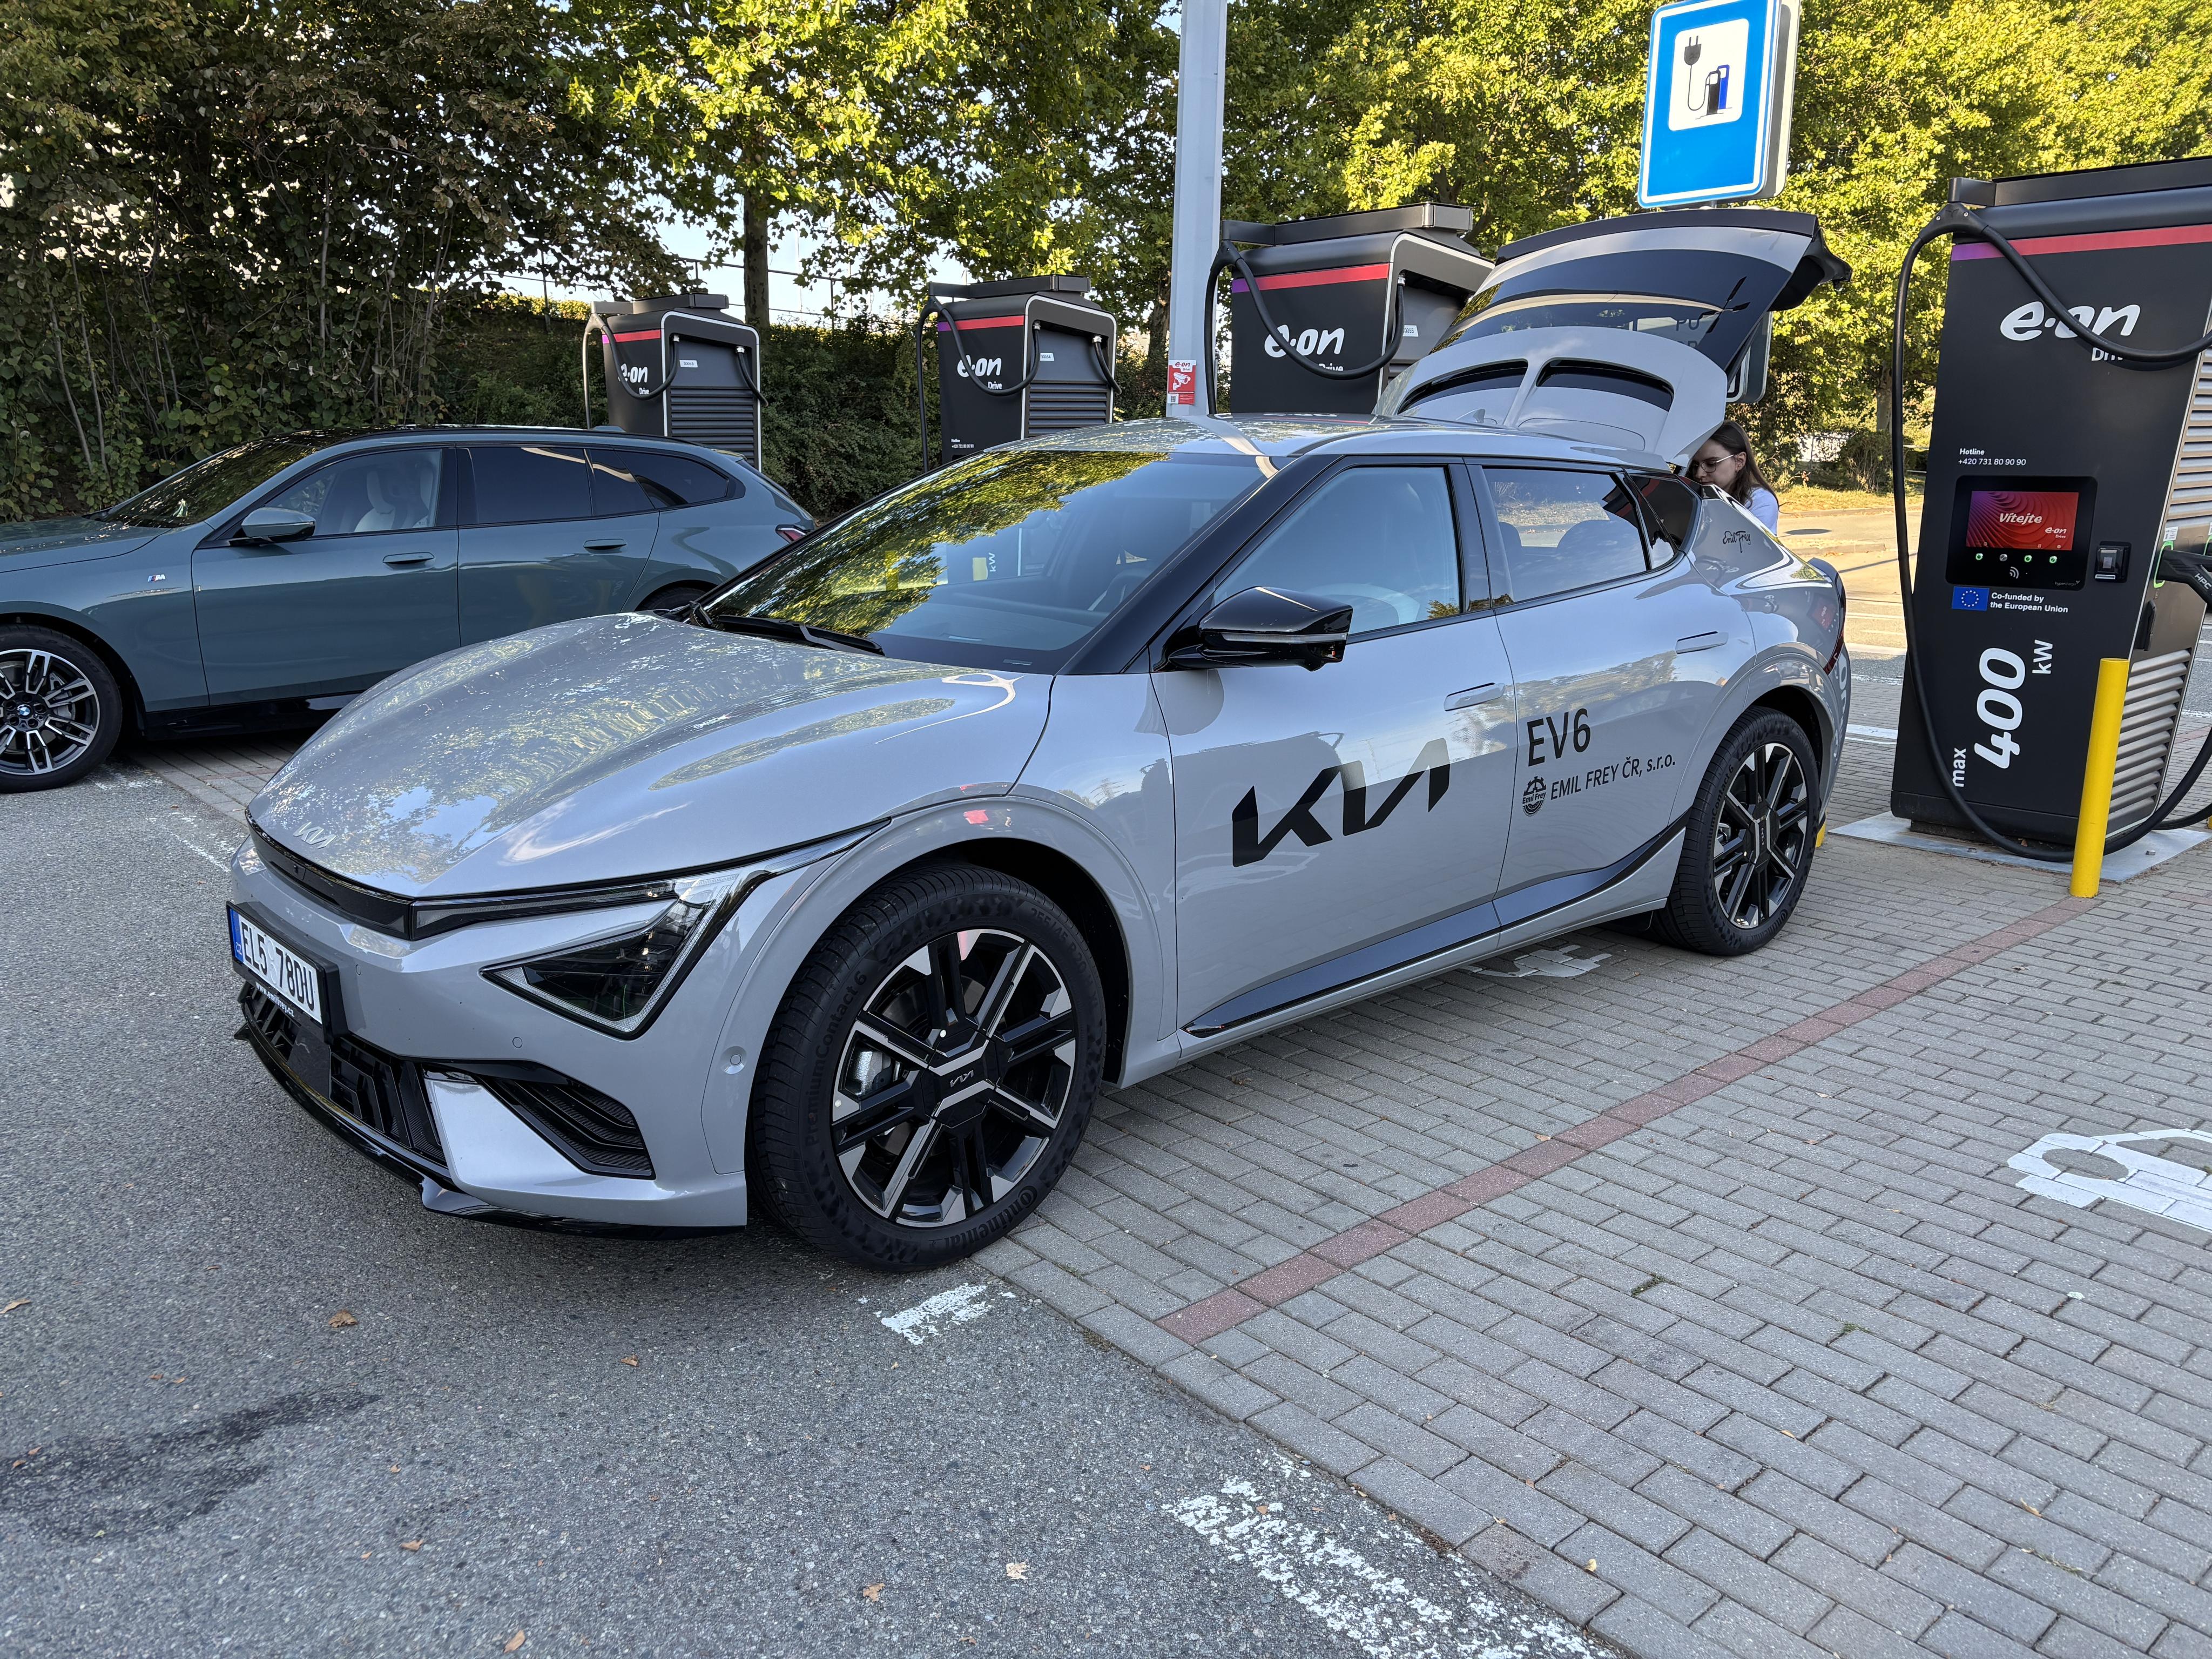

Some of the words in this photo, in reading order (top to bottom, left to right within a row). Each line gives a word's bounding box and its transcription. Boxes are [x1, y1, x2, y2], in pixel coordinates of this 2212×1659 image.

[1999, 512, 2042, 525] Vítejte
[988, 552, 996, 572] kW
[2195, 573, 2212, 590] HPC
[1991, 592, 2032, 601] Co-funded
[2034, 595, 2045, 603] by
[2005, 602, 2042, 611] European
[2032, 639, 2053, 674] kW
[1974, 648, 2026, 769] 400
[1527, 708, 1591, 767] EV6
[1551, 775, 1581, 800] EMIL
[1586, 764, 1620, 790] FREY
[1622, 756, 1642, 777] ČR,
[1647, 754, 1676, 772] s.r.o.
[1728, 764, 1734, 773] 6
[1953, 747, 1966, 787] max
[1232, 737, 1451, 867] KIA
[1522, 794, 1534, 804] Emil
[1535, 792, 1547, 800] Frey
[236, 942, 242, 955] CZ
[241, 921, 267, 975] EL5
[275, 947, 314, 1011] 78DU
[854, 970, 867, 986] 6
[944, 1185, 1037, 1246] Continental
